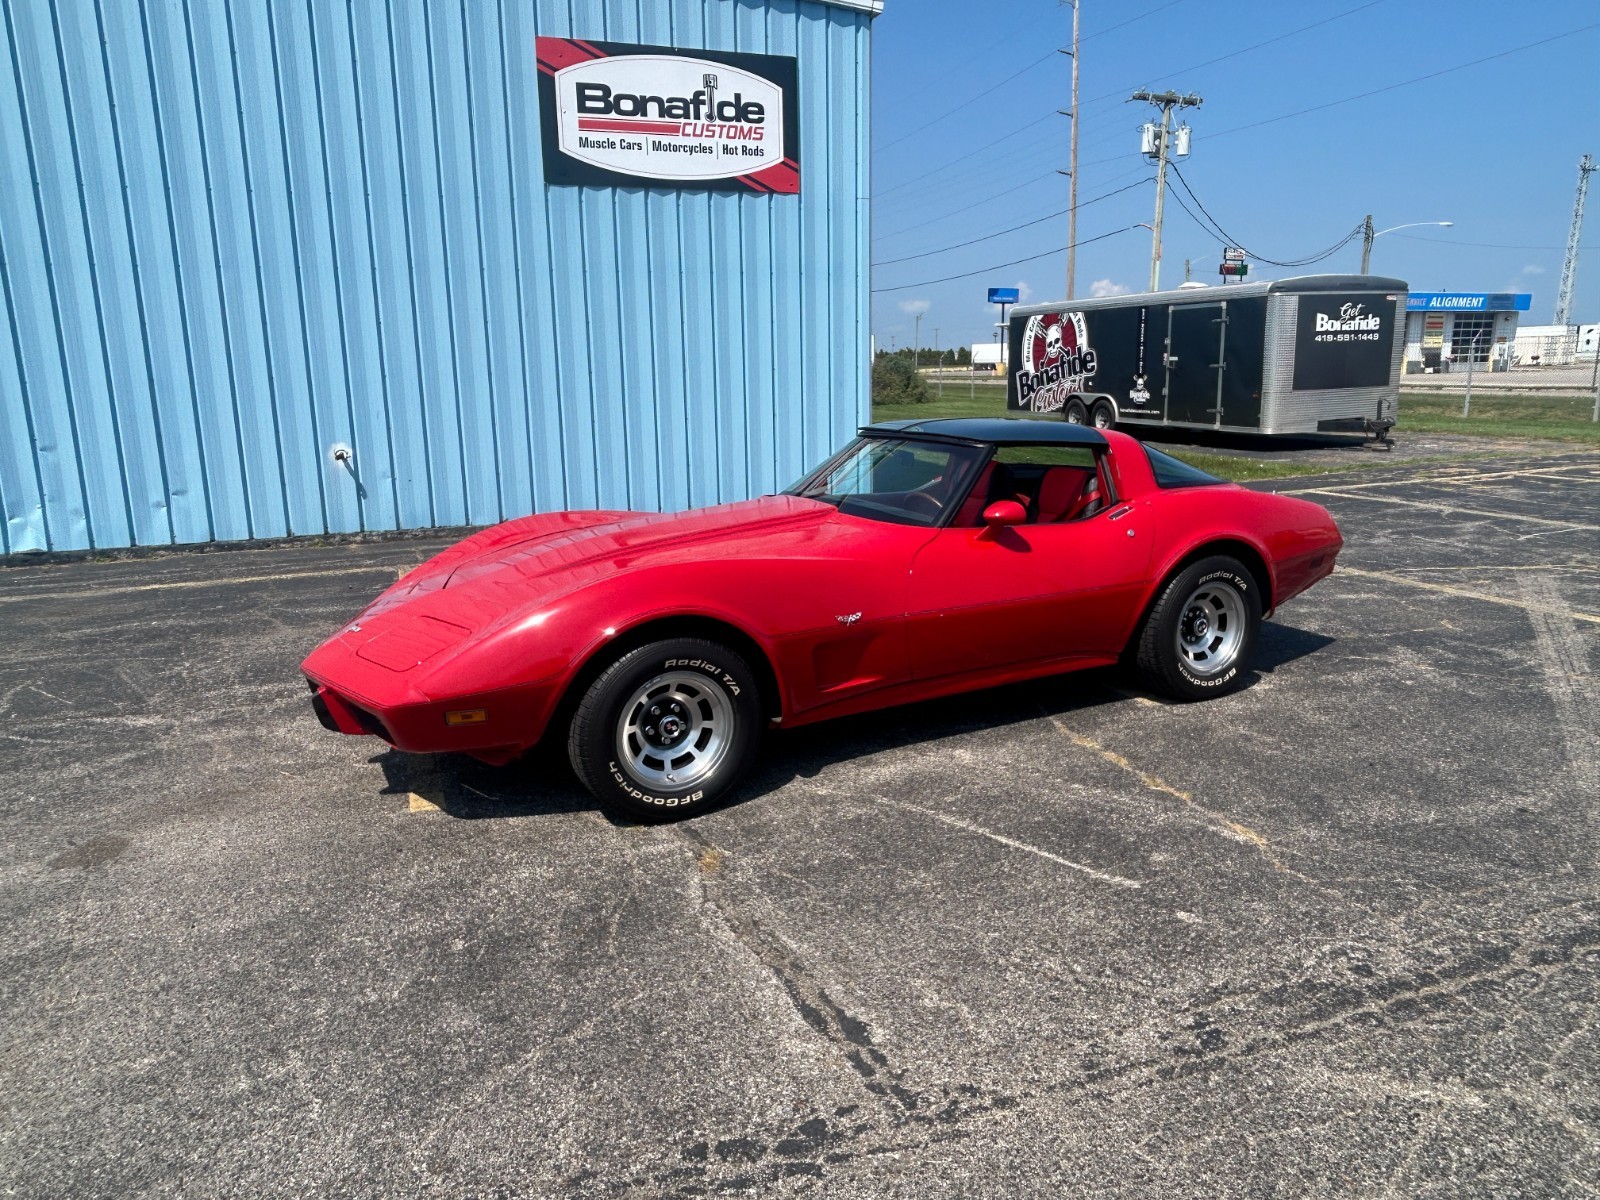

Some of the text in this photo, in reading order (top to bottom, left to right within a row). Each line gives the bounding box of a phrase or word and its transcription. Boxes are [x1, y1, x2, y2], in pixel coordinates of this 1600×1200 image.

[575, 75, 765, 124] Bonafide
[681, 122, 765, 141] CUSTOMS
[578, 136, 765, 157] Muscle Cars Motorcycles Hot Rods
[1406, 297, 1427, 306] ERVICE
[1429, 296, 1484, 307] ALIGNMENT
[1315, 312, 1381, 331] Bonafide
[1340, 302, 1366, 324] Get
[1017, 344, 1097, 405] Bonafide
[1198, 571, 1248, 591] Radial T/A
[664, 658, 741, 696] Radial T/A
[608, 761, 704, 807] BFGoodrich
